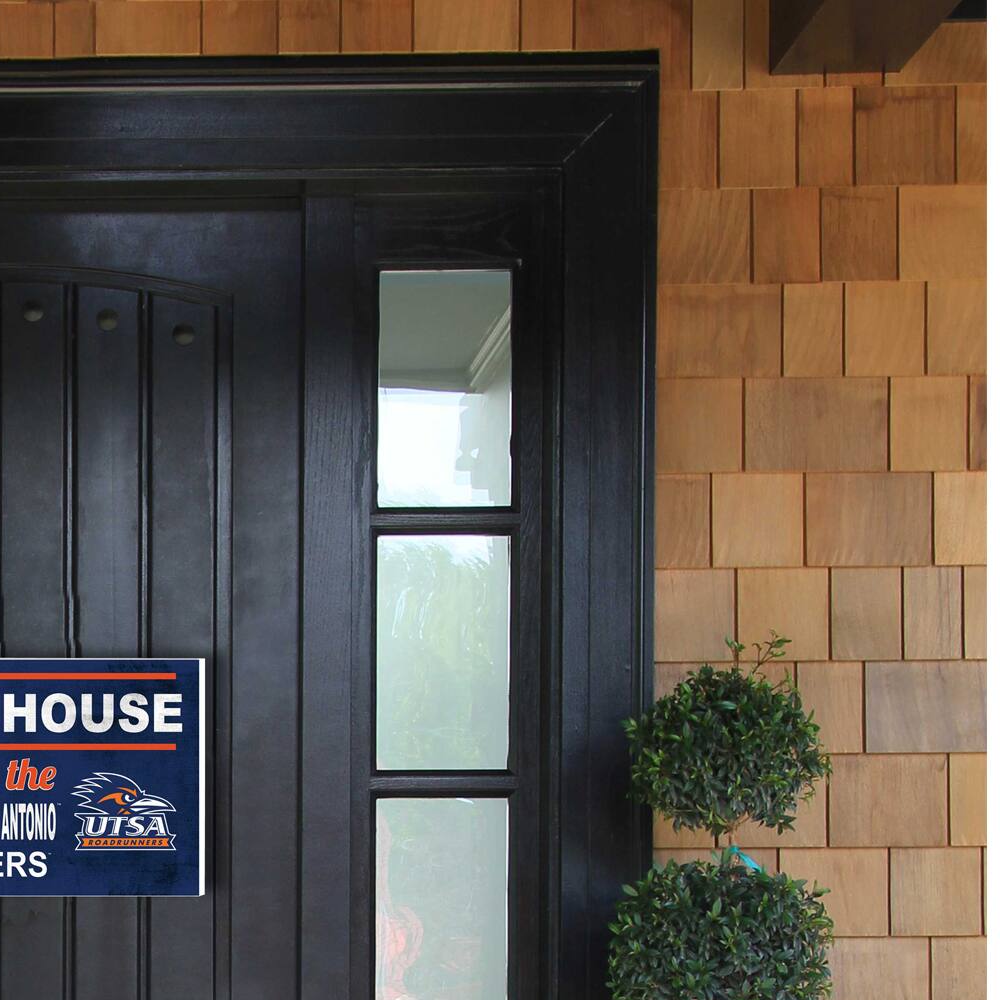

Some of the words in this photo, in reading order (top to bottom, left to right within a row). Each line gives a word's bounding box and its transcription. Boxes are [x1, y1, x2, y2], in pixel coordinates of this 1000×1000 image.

[4, 693, 183, 733] HOUSE
[6, 758, 57, 791] the
[84, 815, 167, 837] UTSA
